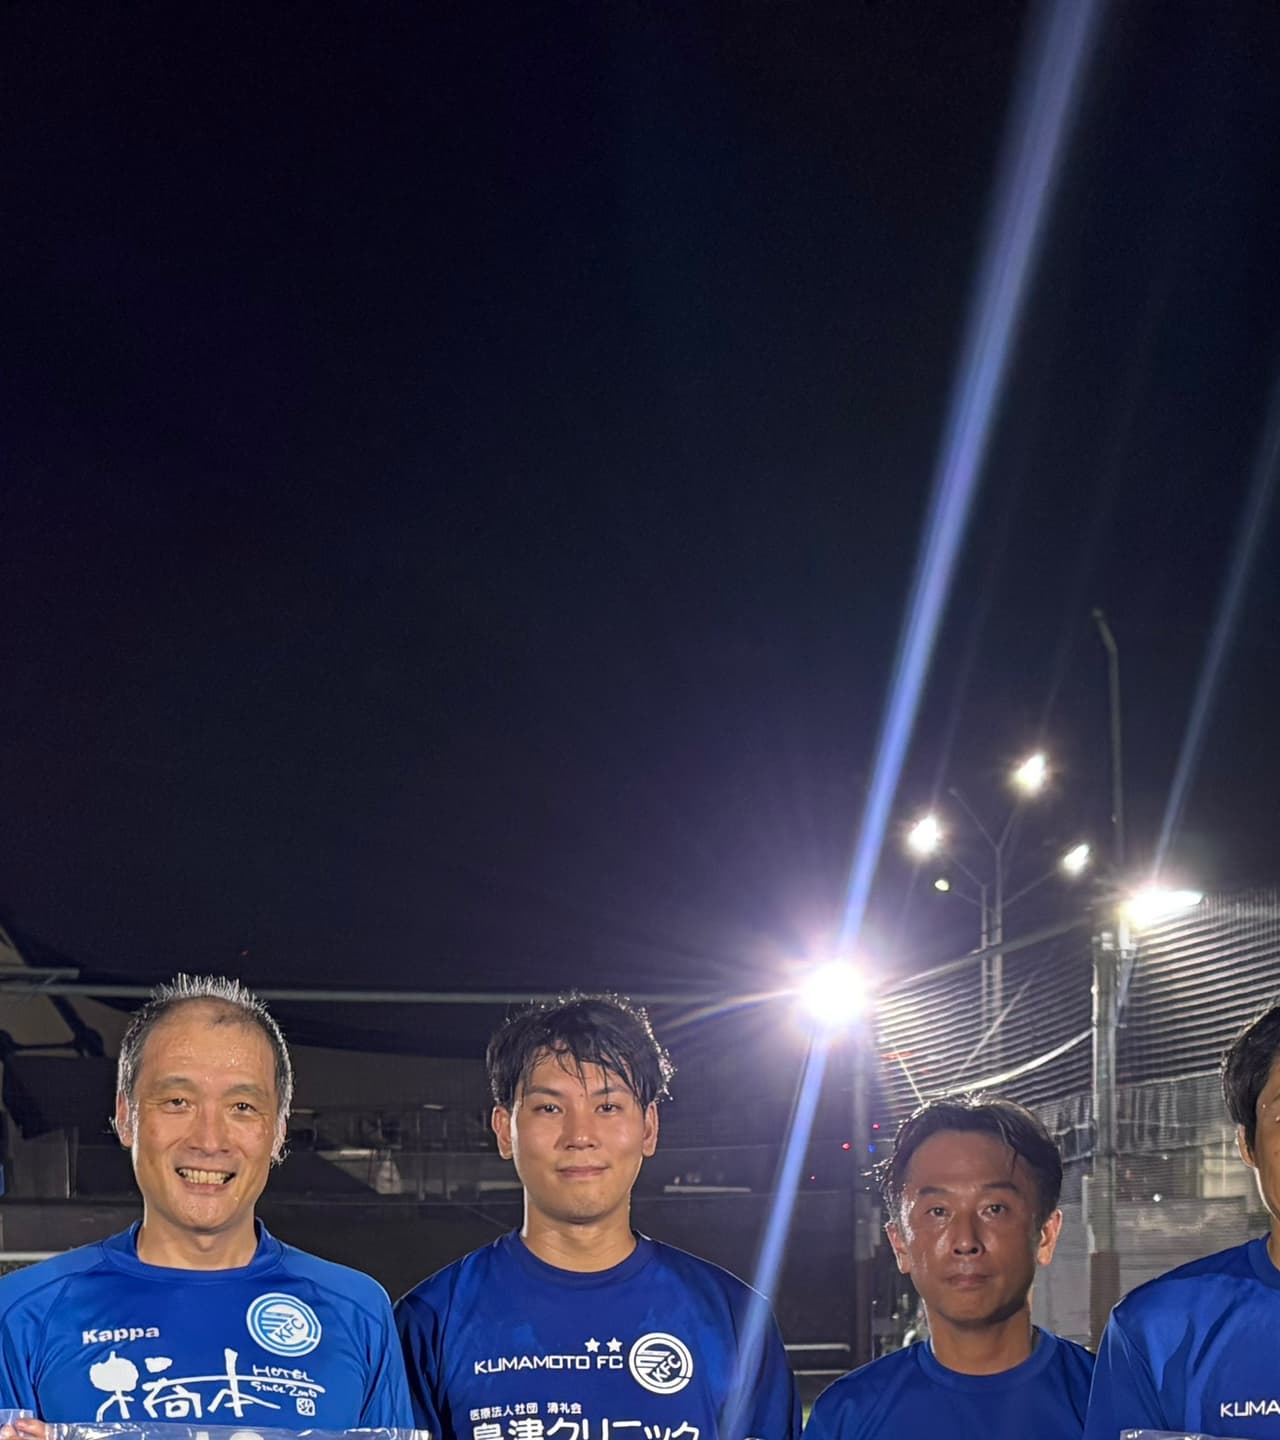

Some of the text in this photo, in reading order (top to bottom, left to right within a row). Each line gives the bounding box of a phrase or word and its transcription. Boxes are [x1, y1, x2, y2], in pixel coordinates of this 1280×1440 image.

[82, 1327, 160, 1345] Kappa
[275, 1317, 305, 1342] KFC
[252, 1363, 315, 1383] HOTEL
[474, 1355, 623, 1375] KUMAMOTO FC
[651, 1354, 682, 1383] KFC
